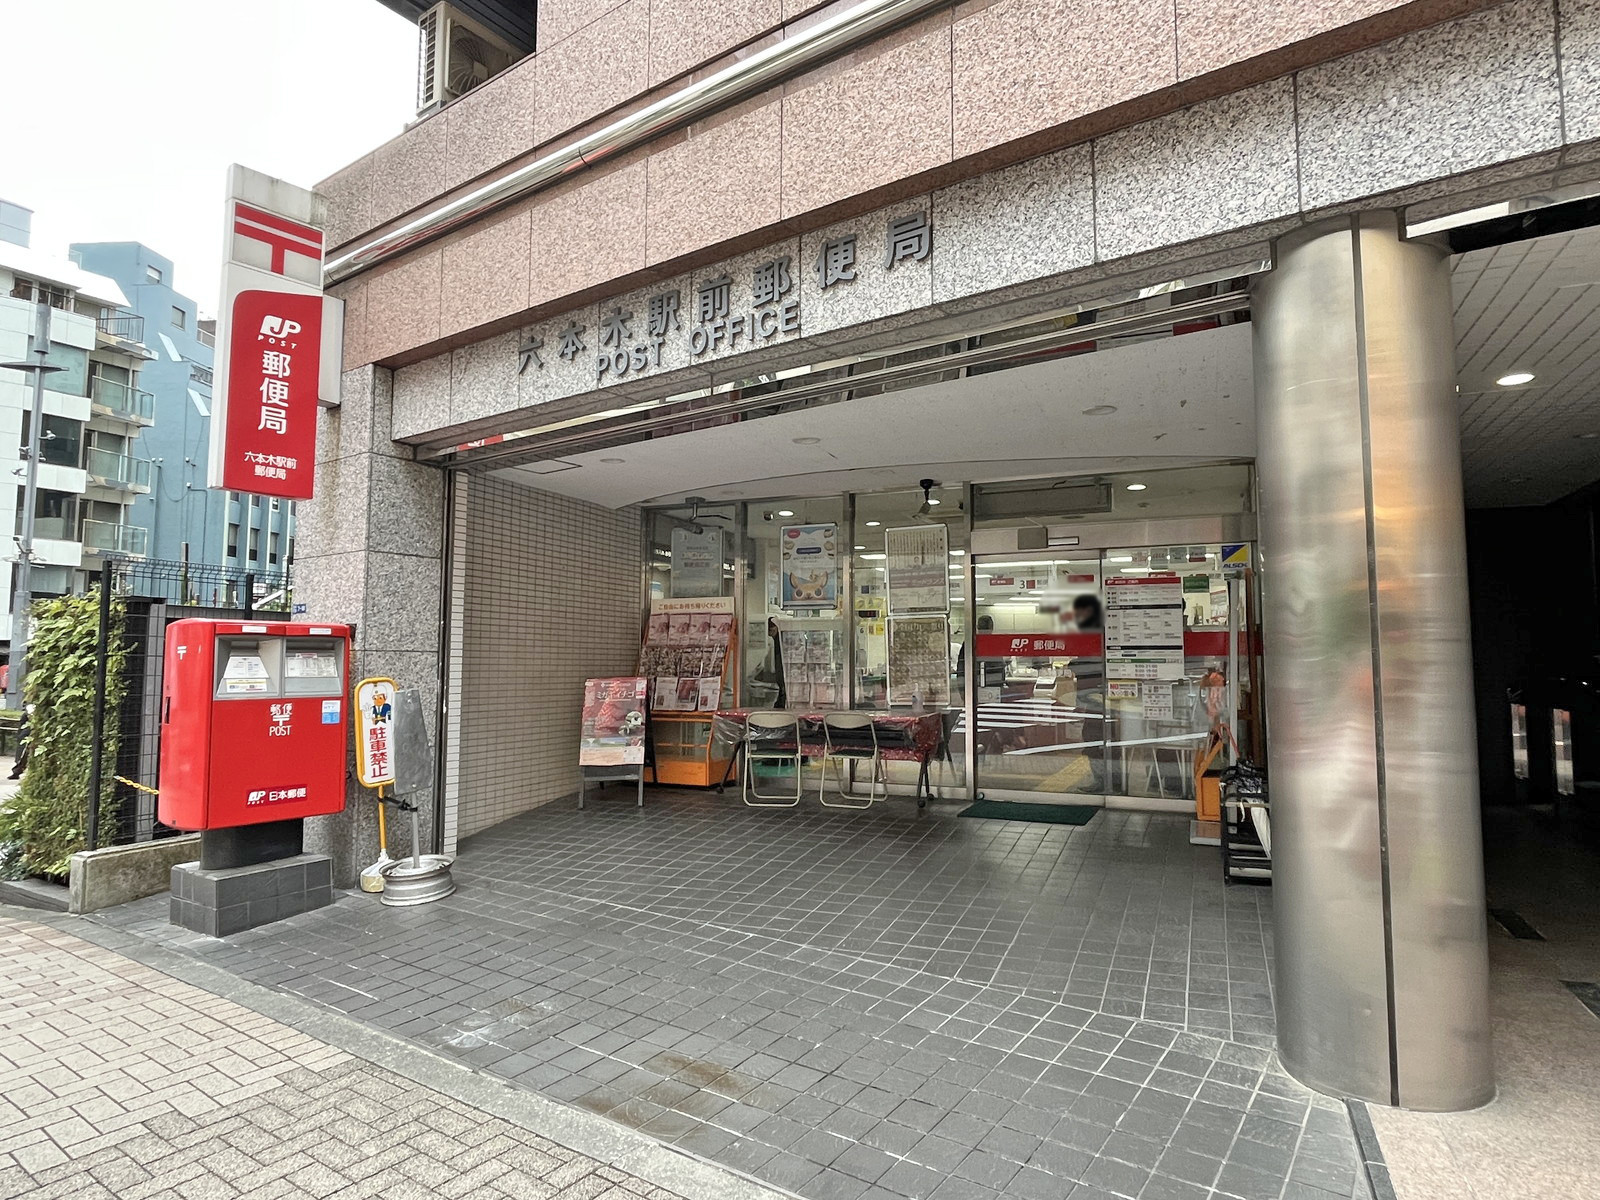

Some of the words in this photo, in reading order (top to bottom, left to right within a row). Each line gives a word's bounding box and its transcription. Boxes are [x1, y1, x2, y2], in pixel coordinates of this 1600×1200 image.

[517, 210, 931, 375] 六本木駅前郵便局
[258, 335, 298, 349] POST
[598, 337, 663, 380] POST
[689, 301, 800, 357] OFFICE
[258, 350, 291, 434] 郵便局
[244, 451, 298, 470] 六本木駅前
[254, 466, 287, 481] 郵便局
[1033, 640, 1066, 651] 郵便局
[270, 703, 293, 715] 郵便
[269, 725, 292, 736] POST
[369, 726, 388, 778] 駐車禁止
[269, 787, 307, 801] 日本郵便
